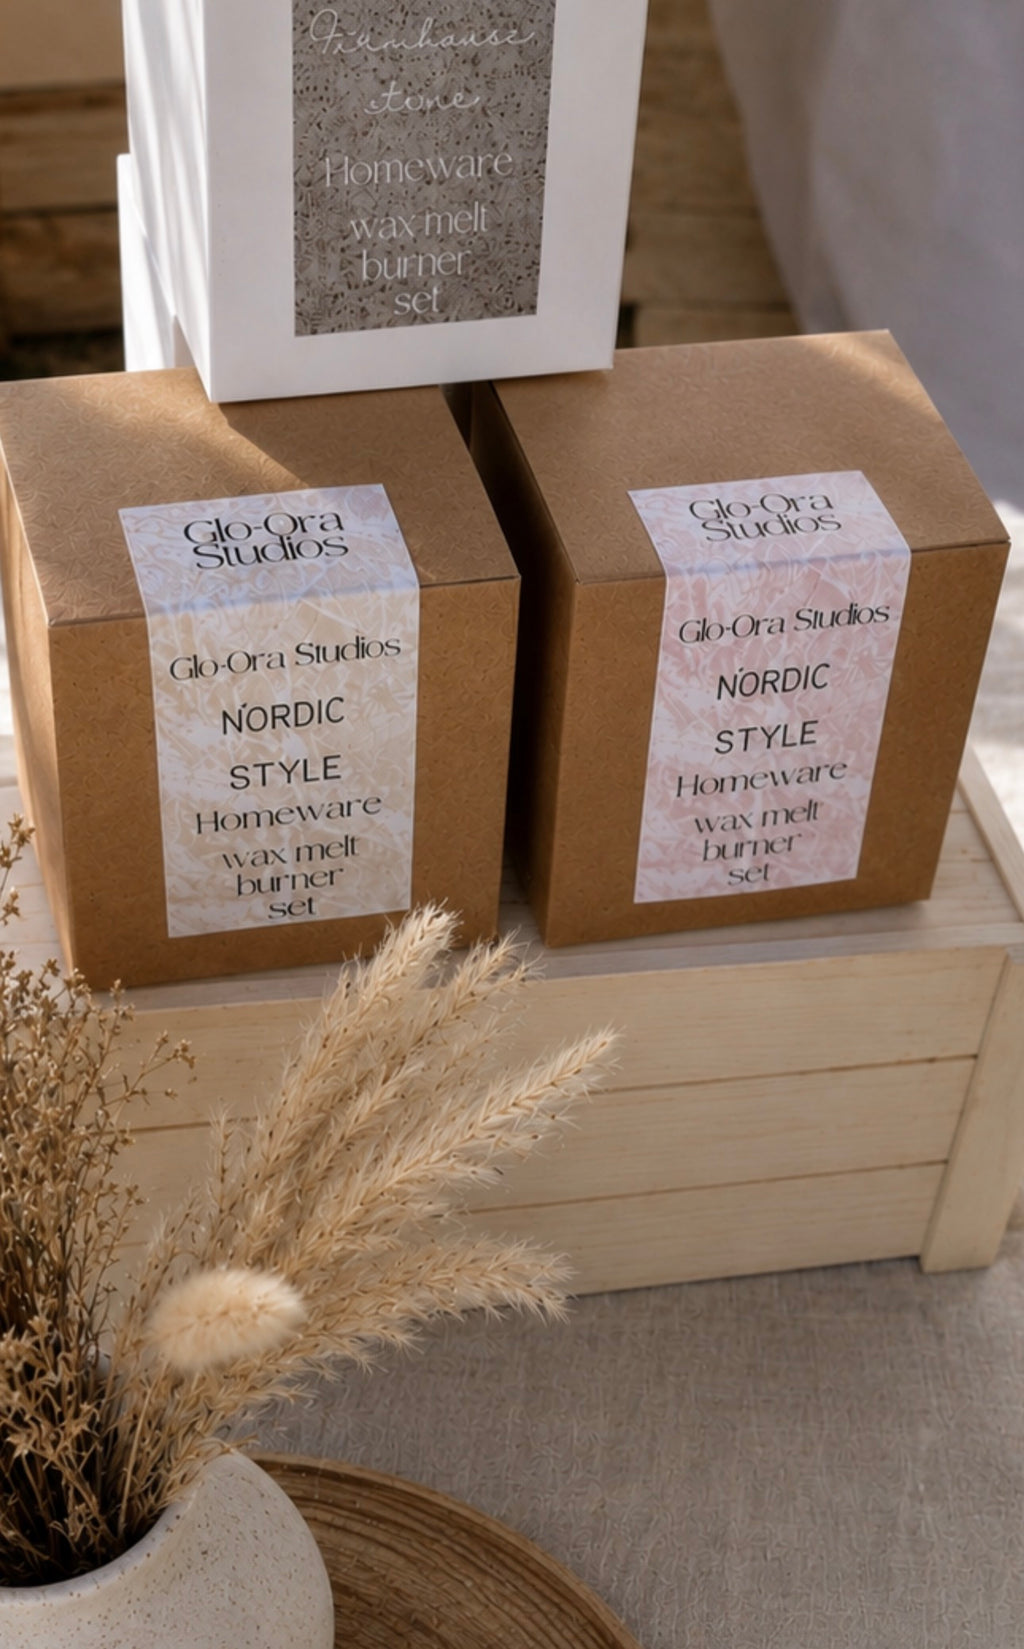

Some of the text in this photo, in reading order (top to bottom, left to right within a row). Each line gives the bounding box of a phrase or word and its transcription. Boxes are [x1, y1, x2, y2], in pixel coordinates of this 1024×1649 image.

[325, 151, 514, 188] Homeware
[350, 201, 488, 241] wax melt
[361, 249, 472, 282] burner
[394, 286, 441, 316] set
[689, 491, 834, 523] Glo-Ora
[184, 510, 344, 548] Glo-Ora
[700, 512, 842, 543] Studios
[192, 535, 348, 571] Studios
[679, 601, 890, 645] Glo-Ora Studios
[169, 635, 402, 682] Glo-Ora Studios
[714, 720, 819, 755] STYLE
[229, 754, 342, 791] STYLE
[676, 759, 848, 798] Homeware
[195, 795, 382, 835] Homeware
[694, 799, 823, 835] wax melt
[220, 834, 361, 870] wax melt
[702, 832, 802, 862] burner
[236, 865, 344, 898] burner
[727, 859, 771, 886] set
[268, 894, 316, 921] set
